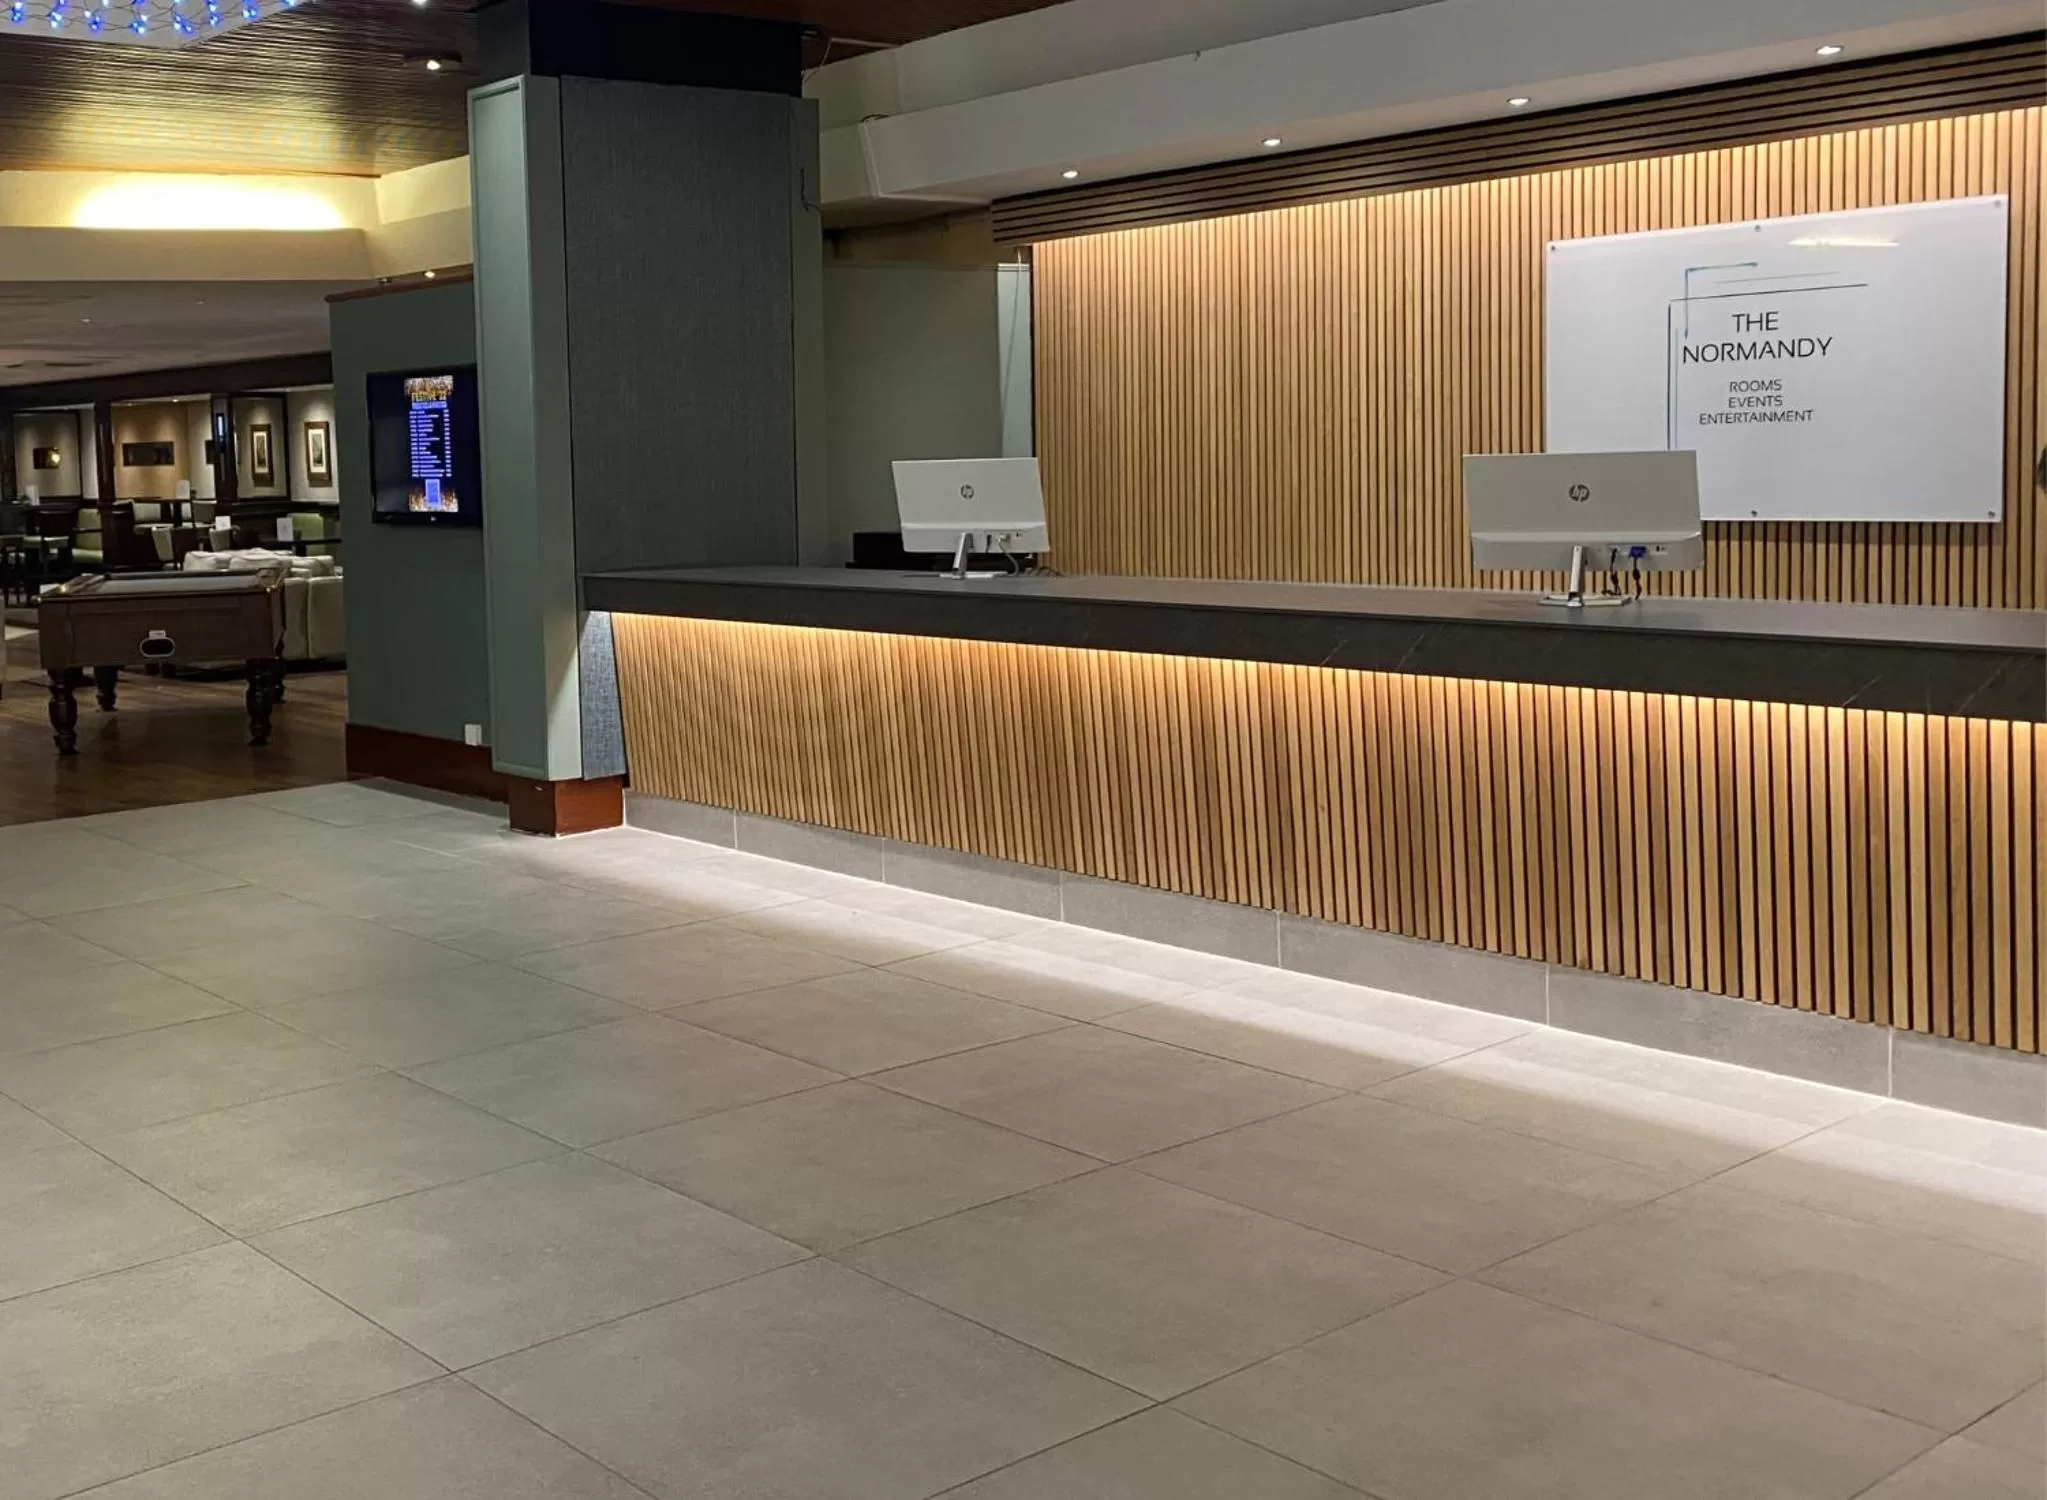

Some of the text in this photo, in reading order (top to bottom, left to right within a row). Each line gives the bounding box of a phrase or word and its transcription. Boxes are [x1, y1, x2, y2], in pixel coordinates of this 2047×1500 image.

[1732, 311, 1779, 333] THE
[1683, 337, 1832, 364] NORMANDY
[1729, 379, 1783, 392] ROOMS
[1728, 395, 1783, 409] EVENTS
[1699, 410, 1814, 425] ENTERTAINMENT
[1569, 484, 1590, 502] hp
